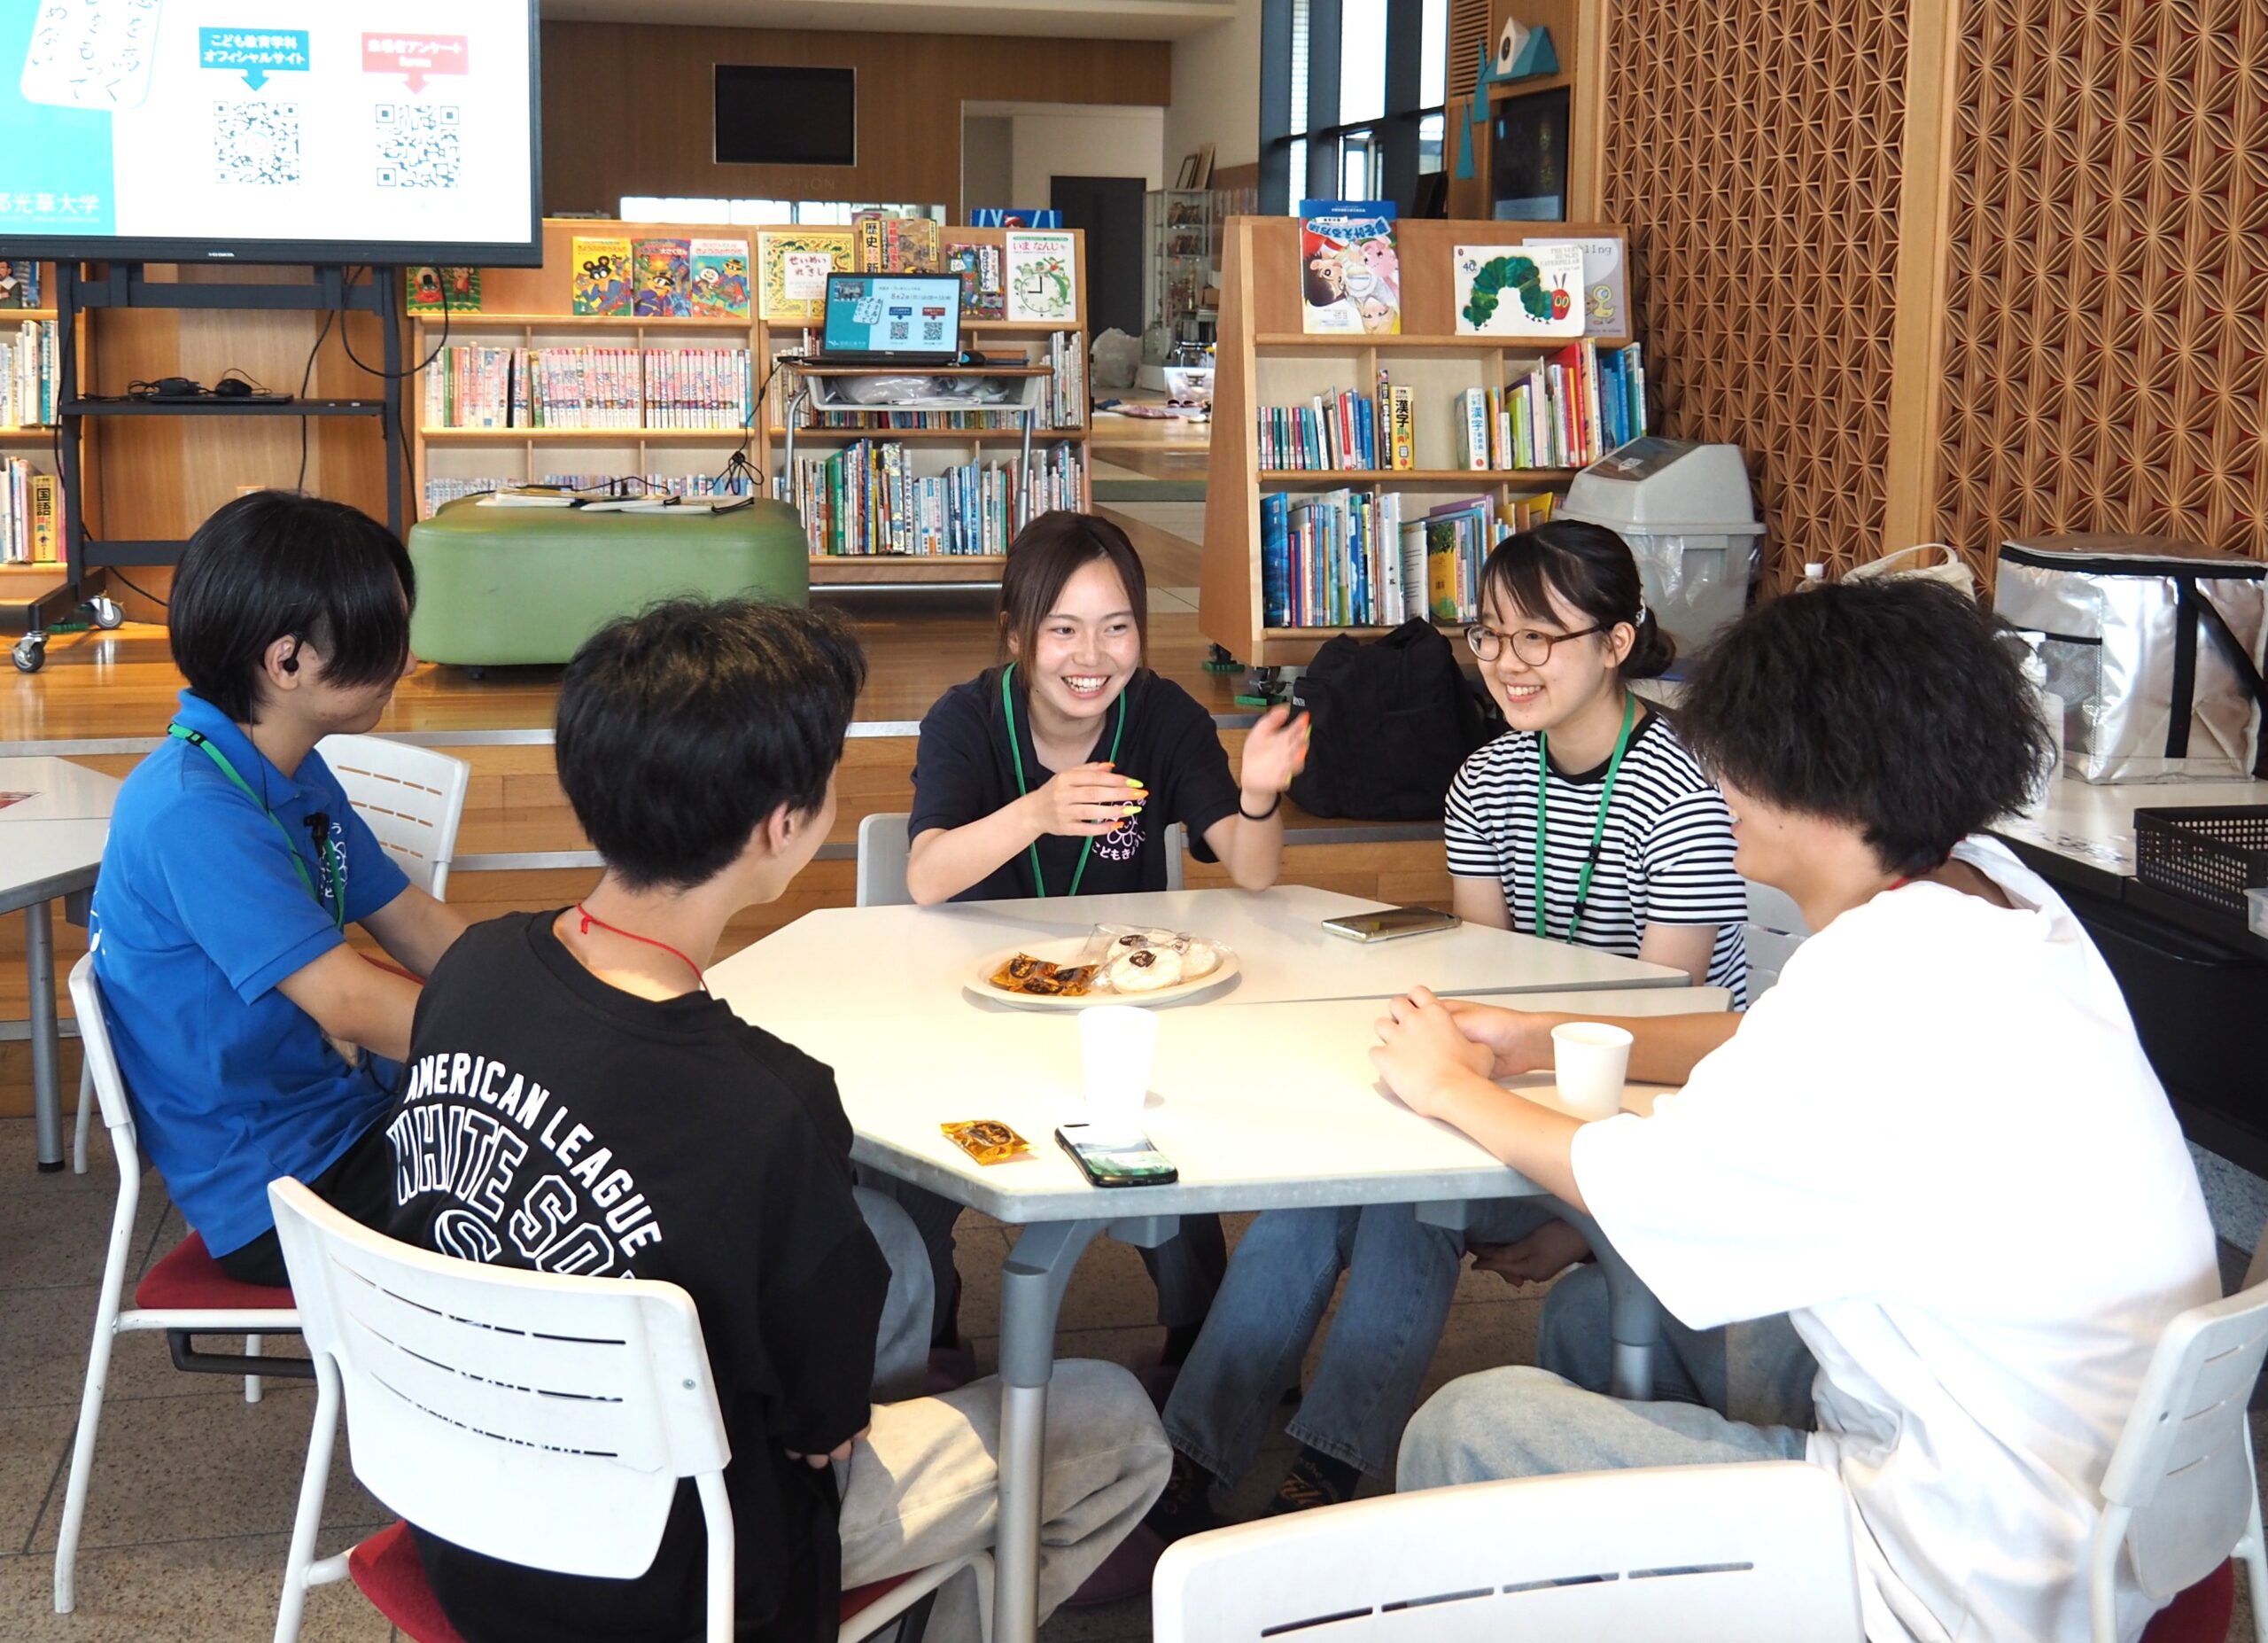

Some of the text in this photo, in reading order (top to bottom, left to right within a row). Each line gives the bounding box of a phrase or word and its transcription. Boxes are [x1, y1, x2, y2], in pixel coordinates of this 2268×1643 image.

[204, 49, 306, 65] オフィシャルサイト
[1013, 241, 1060, 252] いま なんじ
[789, 255, 827, 266] せいめい
[795, 268, 826, 277] れきし
[403, 1053, 550, 1131] AMERICAN
[540, 1105, 663, 1258] LEAGUE
[509, 1174, 636, 1281] SO
